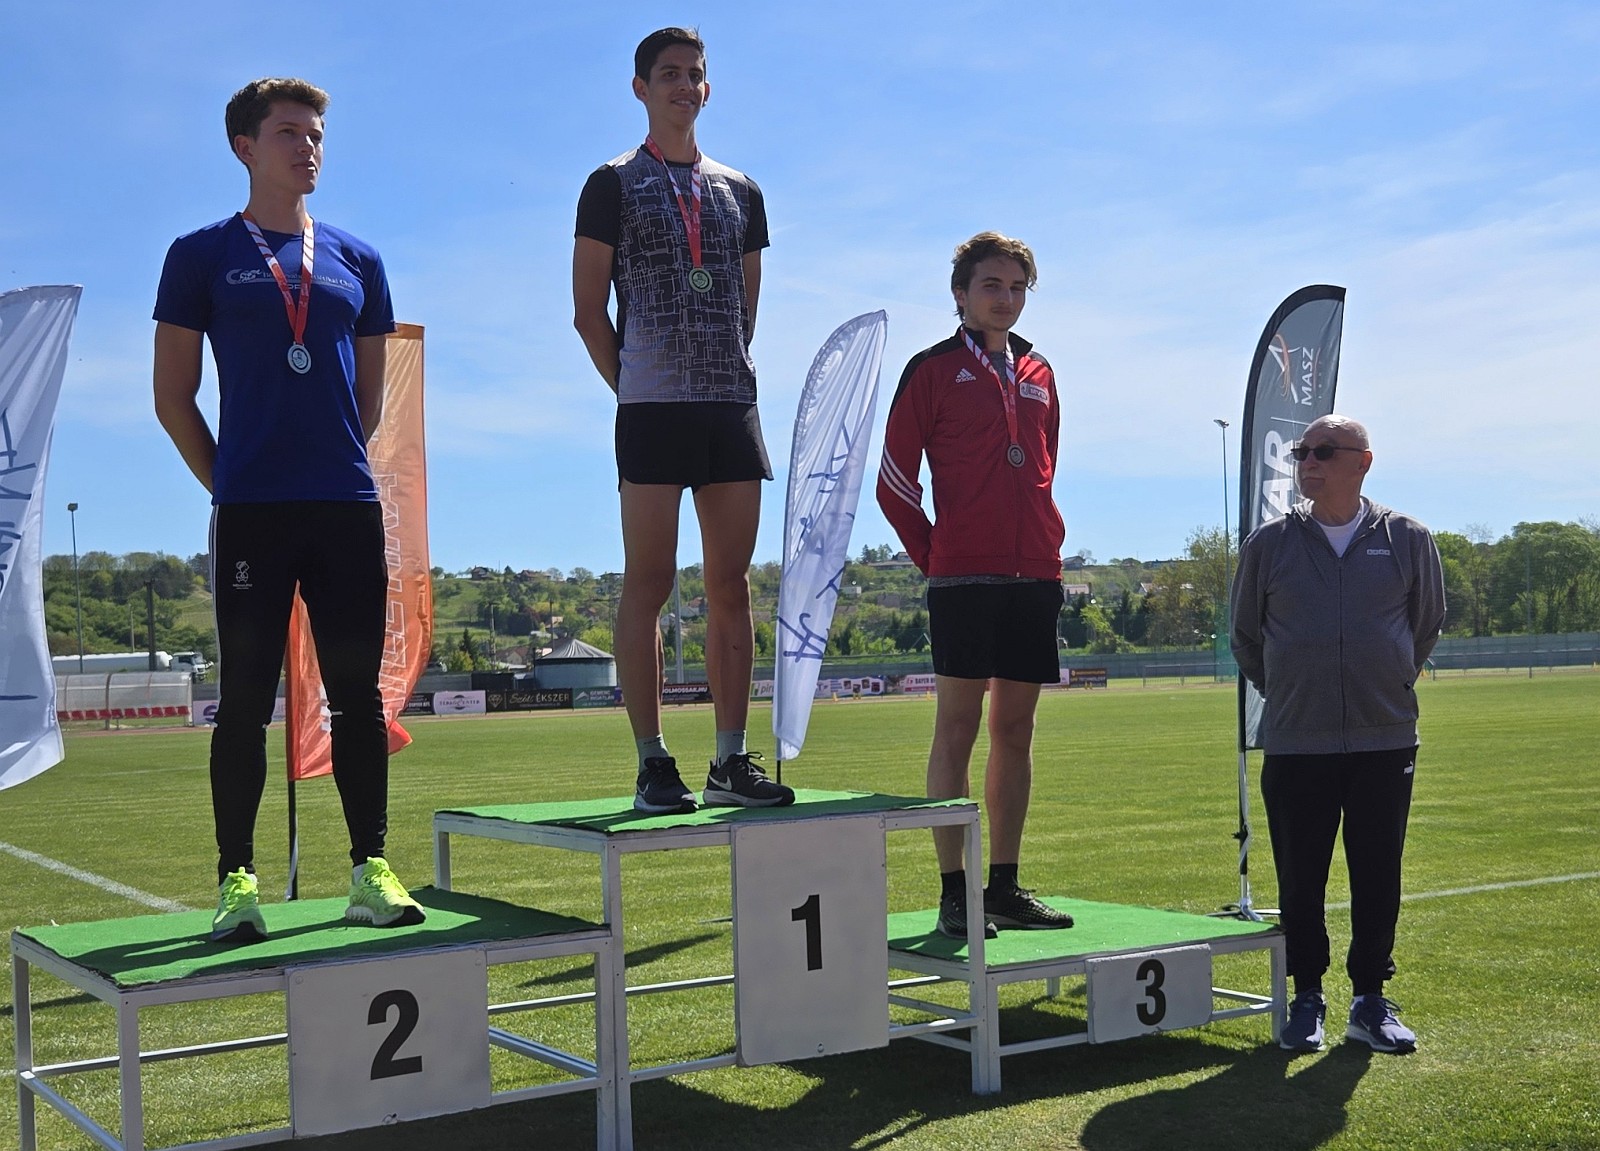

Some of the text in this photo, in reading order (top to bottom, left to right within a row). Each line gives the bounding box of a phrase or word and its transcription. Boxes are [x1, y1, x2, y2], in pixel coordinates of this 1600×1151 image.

[1301, 346, 1314, 406] MASZ
[535, 692, 570, 703] ÉKSZER
[791, 894, 823, 971] 1
[1136, 959, 1166, 1026] 3
[367, 989, 422, 1080] 2
